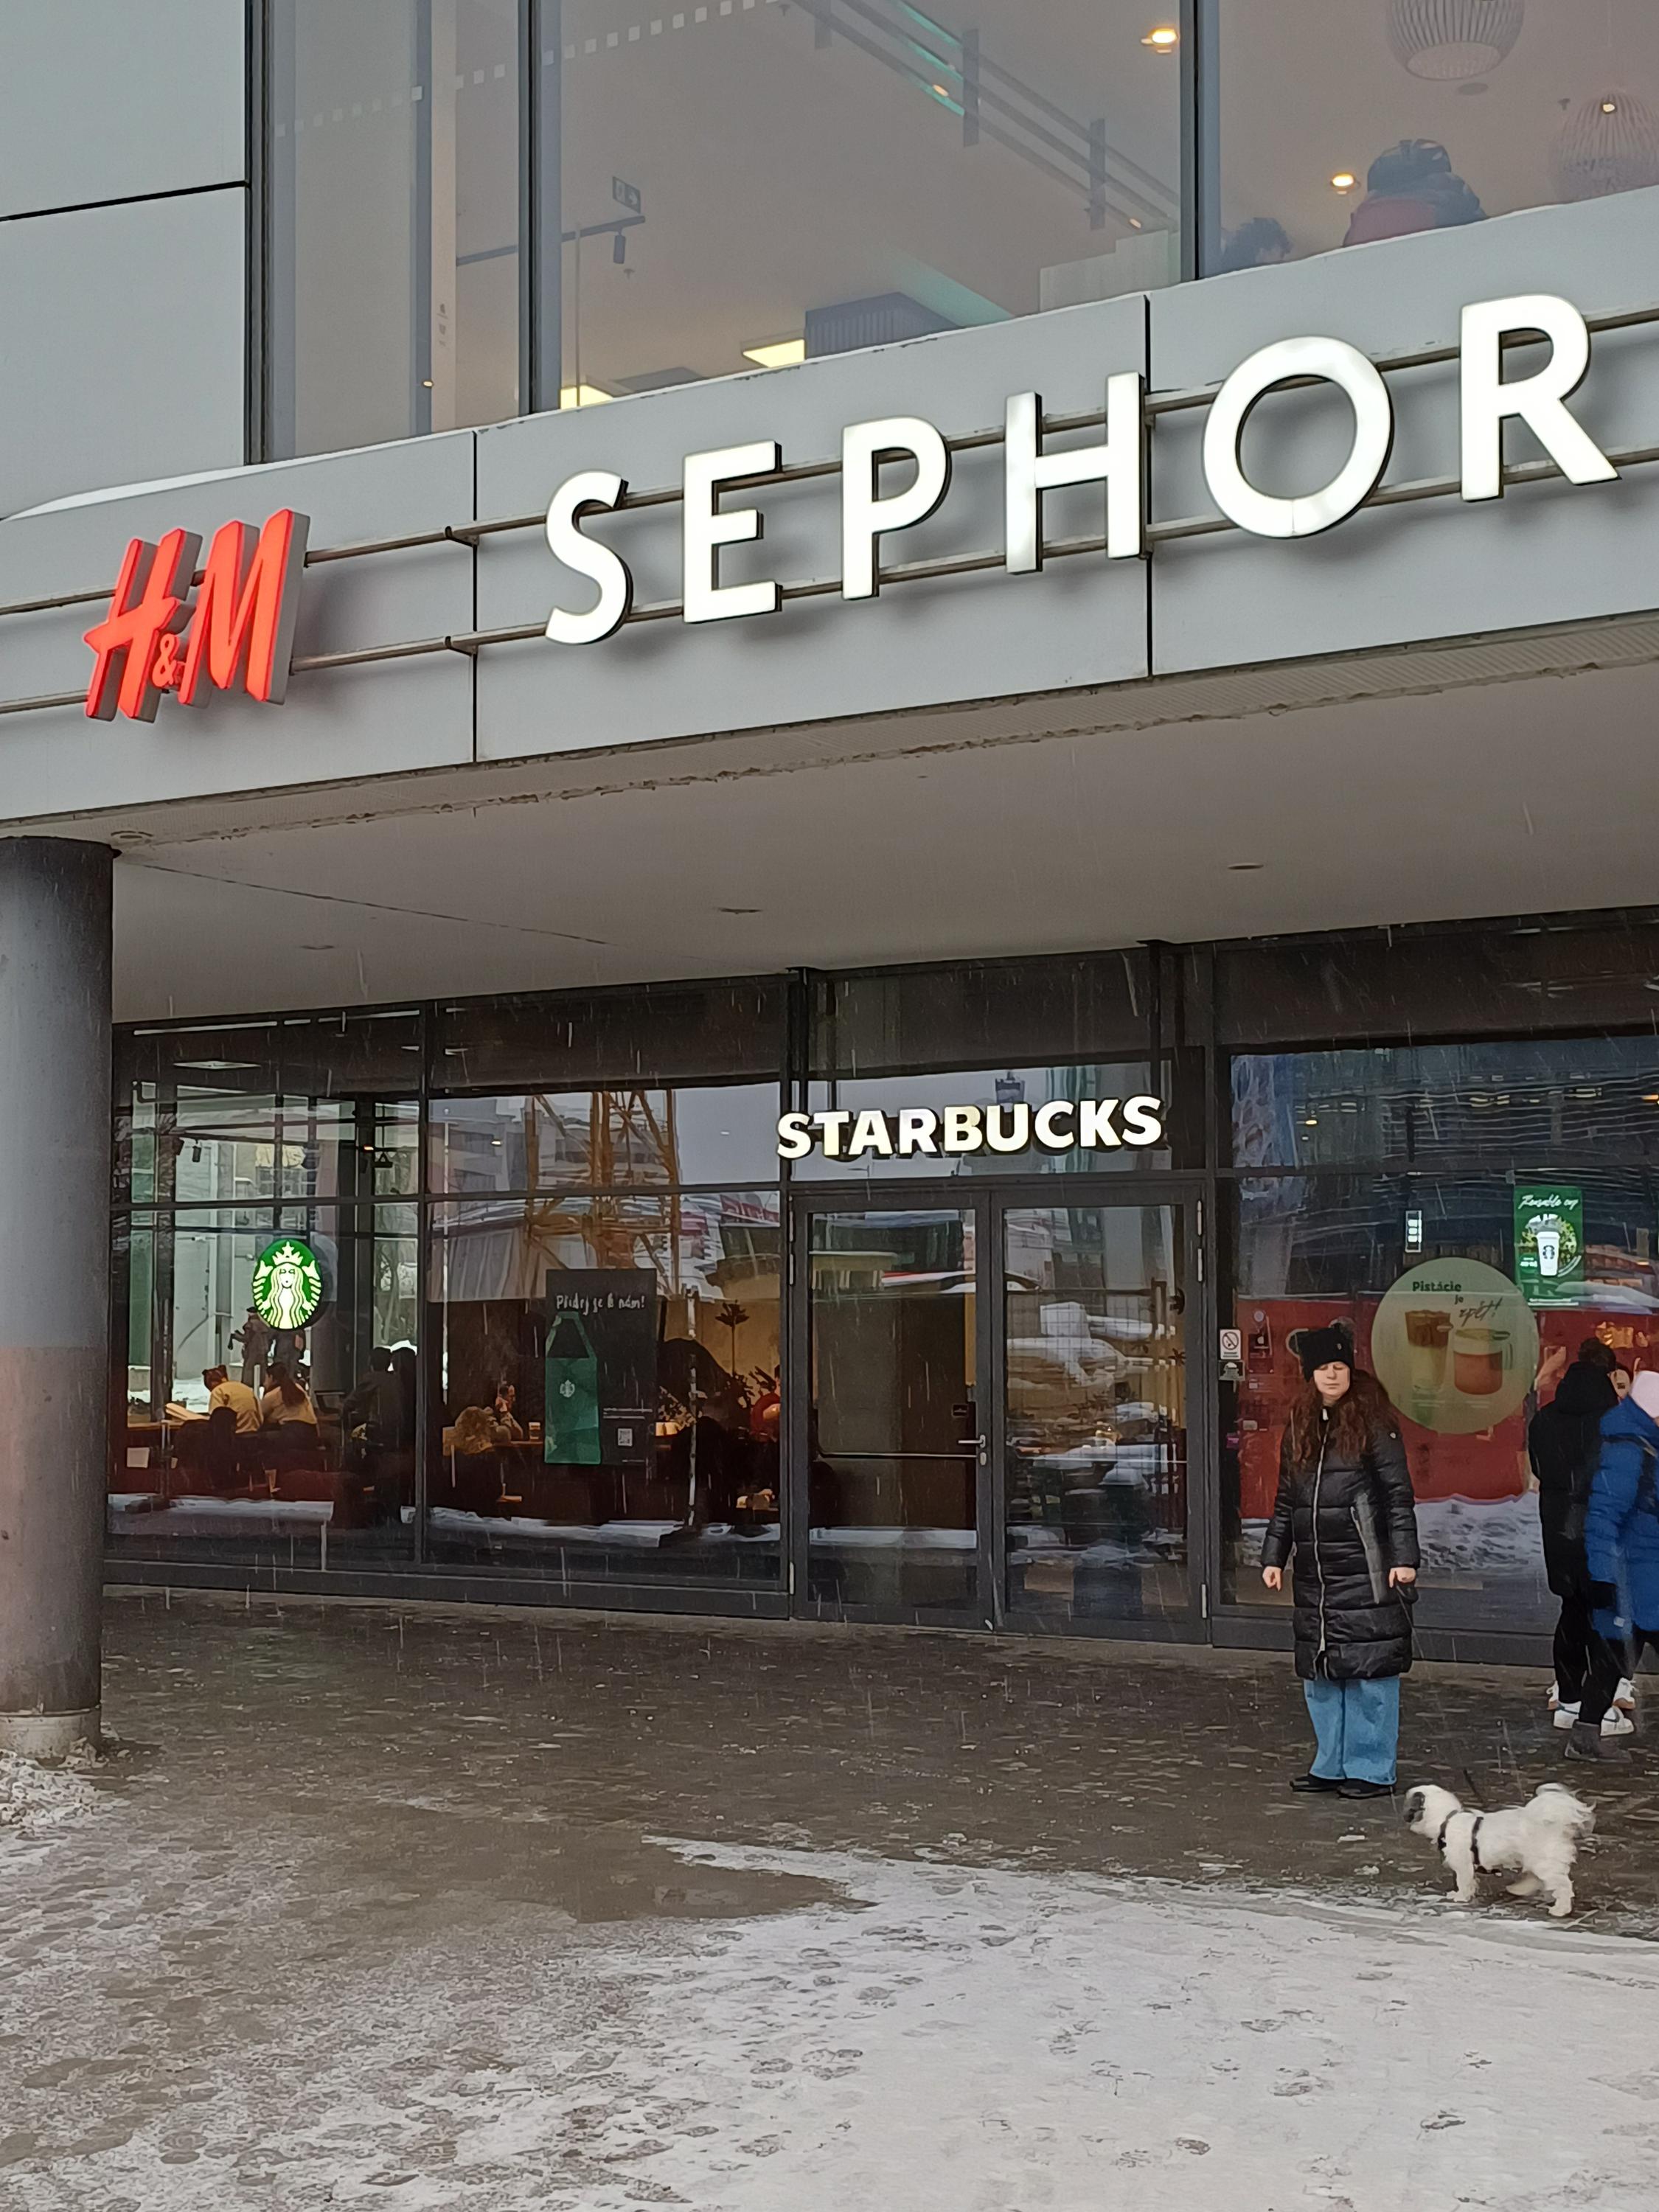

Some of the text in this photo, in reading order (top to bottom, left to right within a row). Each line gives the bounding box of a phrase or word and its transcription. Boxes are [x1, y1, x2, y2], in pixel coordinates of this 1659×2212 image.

[546, 293, 1620, 646] SEPHOR
[84, 509, 298, 720] H&M
[777, 1096, 1162, 1158] STARBUCKS
[1412, 1281, 1462, 1292] Pistácie
